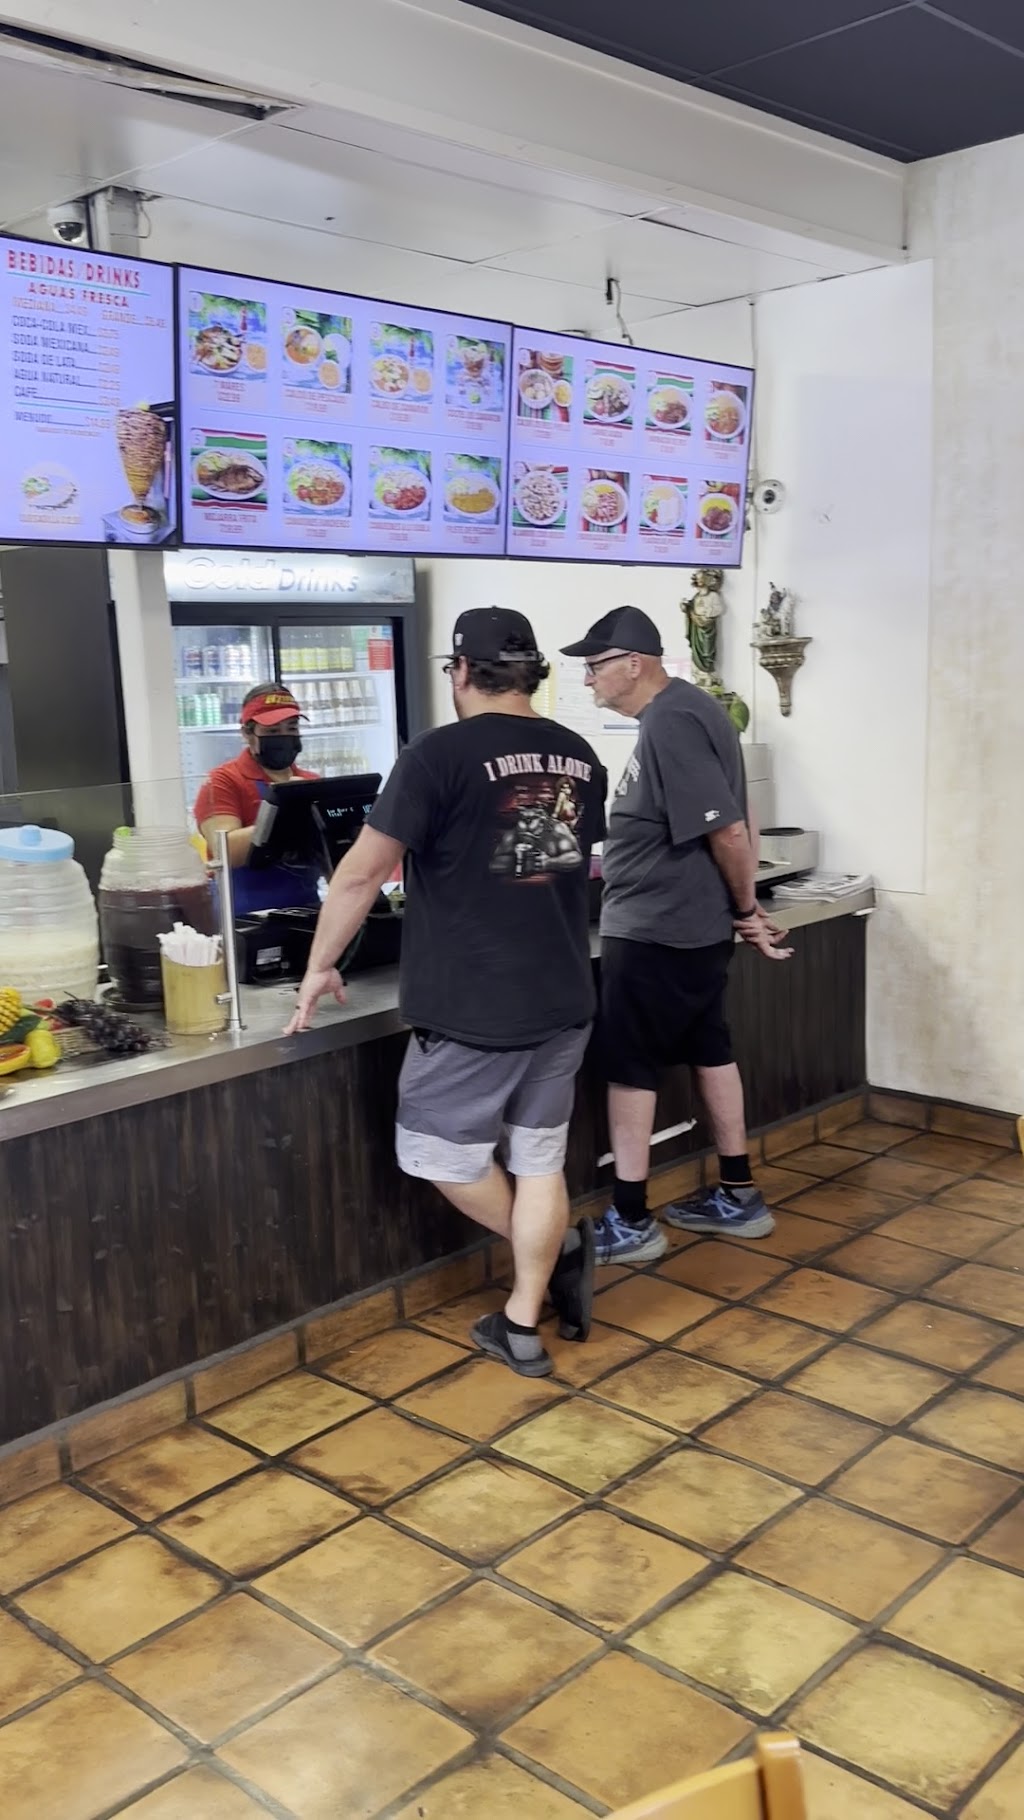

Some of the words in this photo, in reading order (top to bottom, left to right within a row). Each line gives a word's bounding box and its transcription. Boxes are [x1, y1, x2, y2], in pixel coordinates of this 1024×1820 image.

[28, 281, 75, 300] AGUAS
[82, 289, 129, 308] FRESCA
[12, 314, 65, 333] COCA-COLA
[12, 333, 38, 346] SODA
[41, 336, 89, 353] MEXICANA
[12, 350, 38, 364] SODA
[41, 354, 53, 366] DE
[55, 356, 76, 369] LATA
[14, 368, 39, 382] AGUA
[41, 371, 80, 387] NATURAL
[184, 556, 276, 591] Cold
[277, 567, 359, 592] Drinks
[483, 761, 498, 782] I
[495, 753, 544, 777] DRINK
[547, 754, 592, 782] ALONE
